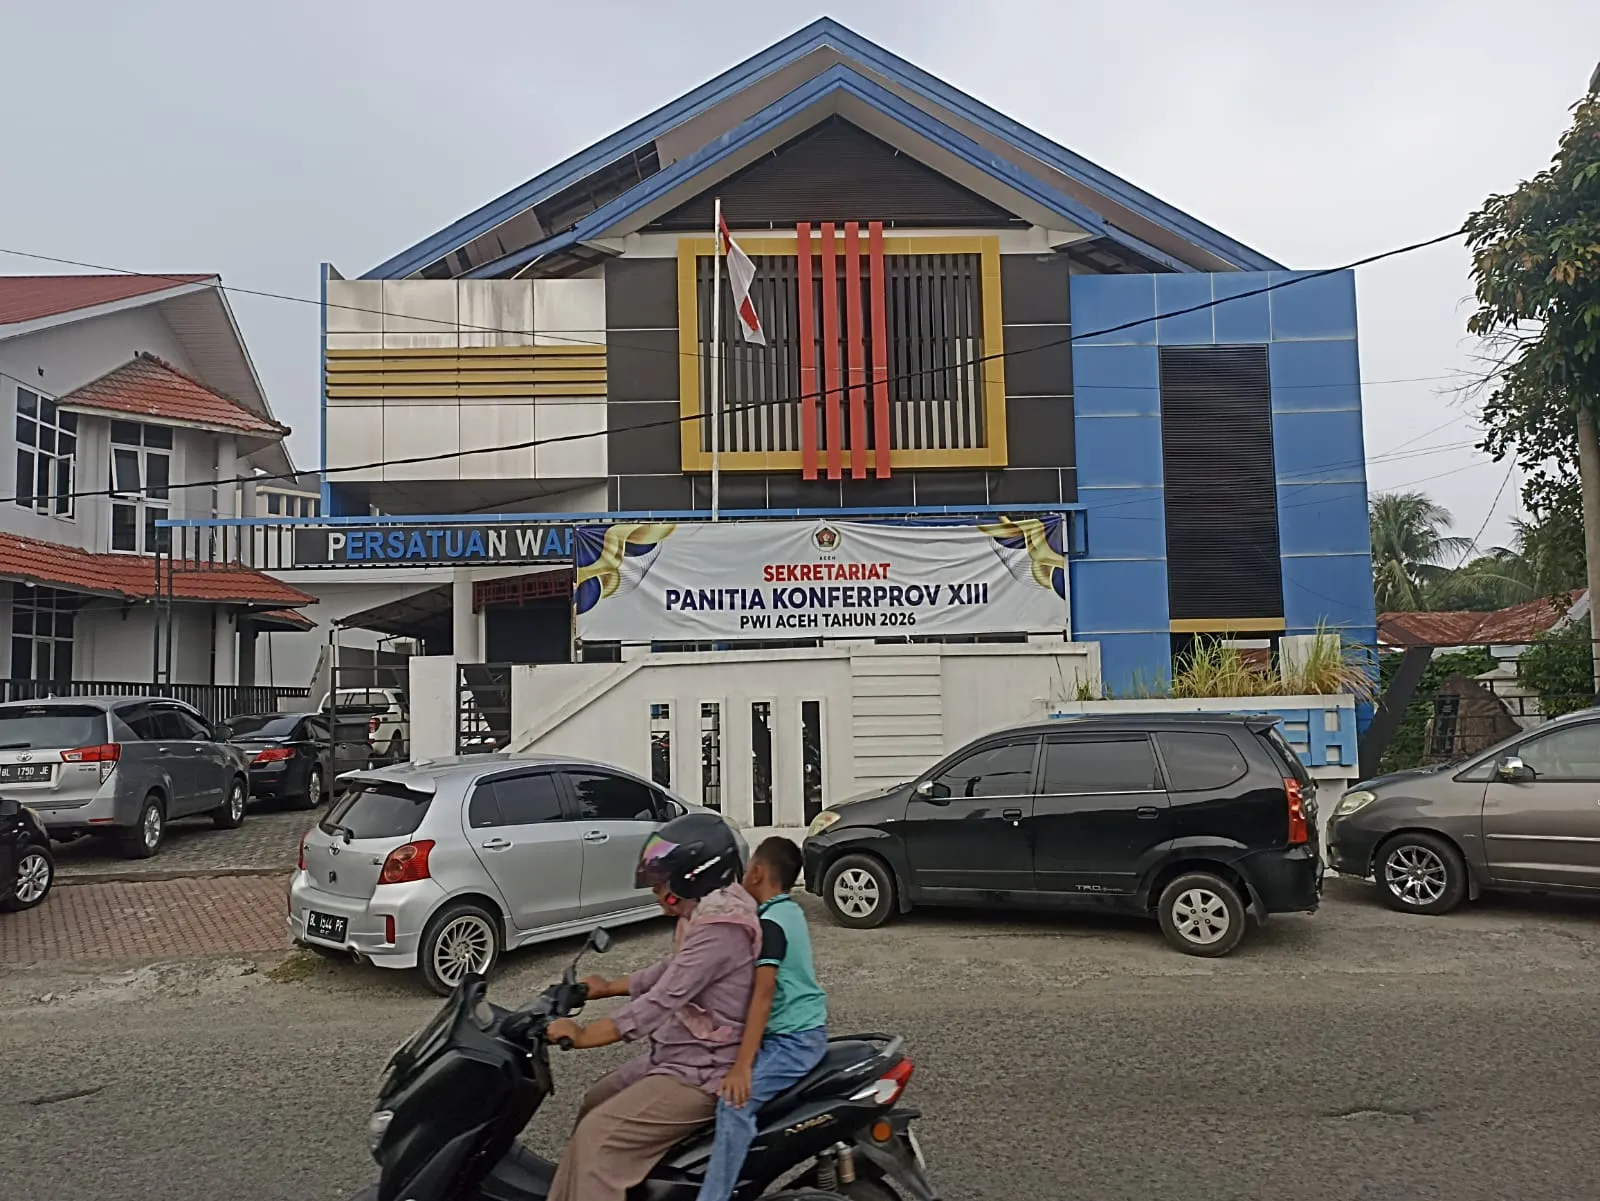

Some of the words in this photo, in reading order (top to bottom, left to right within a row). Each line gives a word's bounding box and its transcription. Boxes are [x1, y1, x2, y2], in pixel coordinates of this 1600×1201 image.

[328, 529, 506, 560] PERSATUAN
[763, 563, 891, 582] SEKRETARIAT
[665, 588, 767, 611] PANITIA
[773, 584, 942, 609] KONFERPROV
[947, 582, 988, 606] XIII
[740, 615, 771, 629] PWI
[776, 614, 818, 628] ACEH
[822, 613, 875, 627] TAHUN
[880, 612, 916, 626] 2026
[17, 766, 35, 777] 1750
[39, 765, 49, 775] JE
